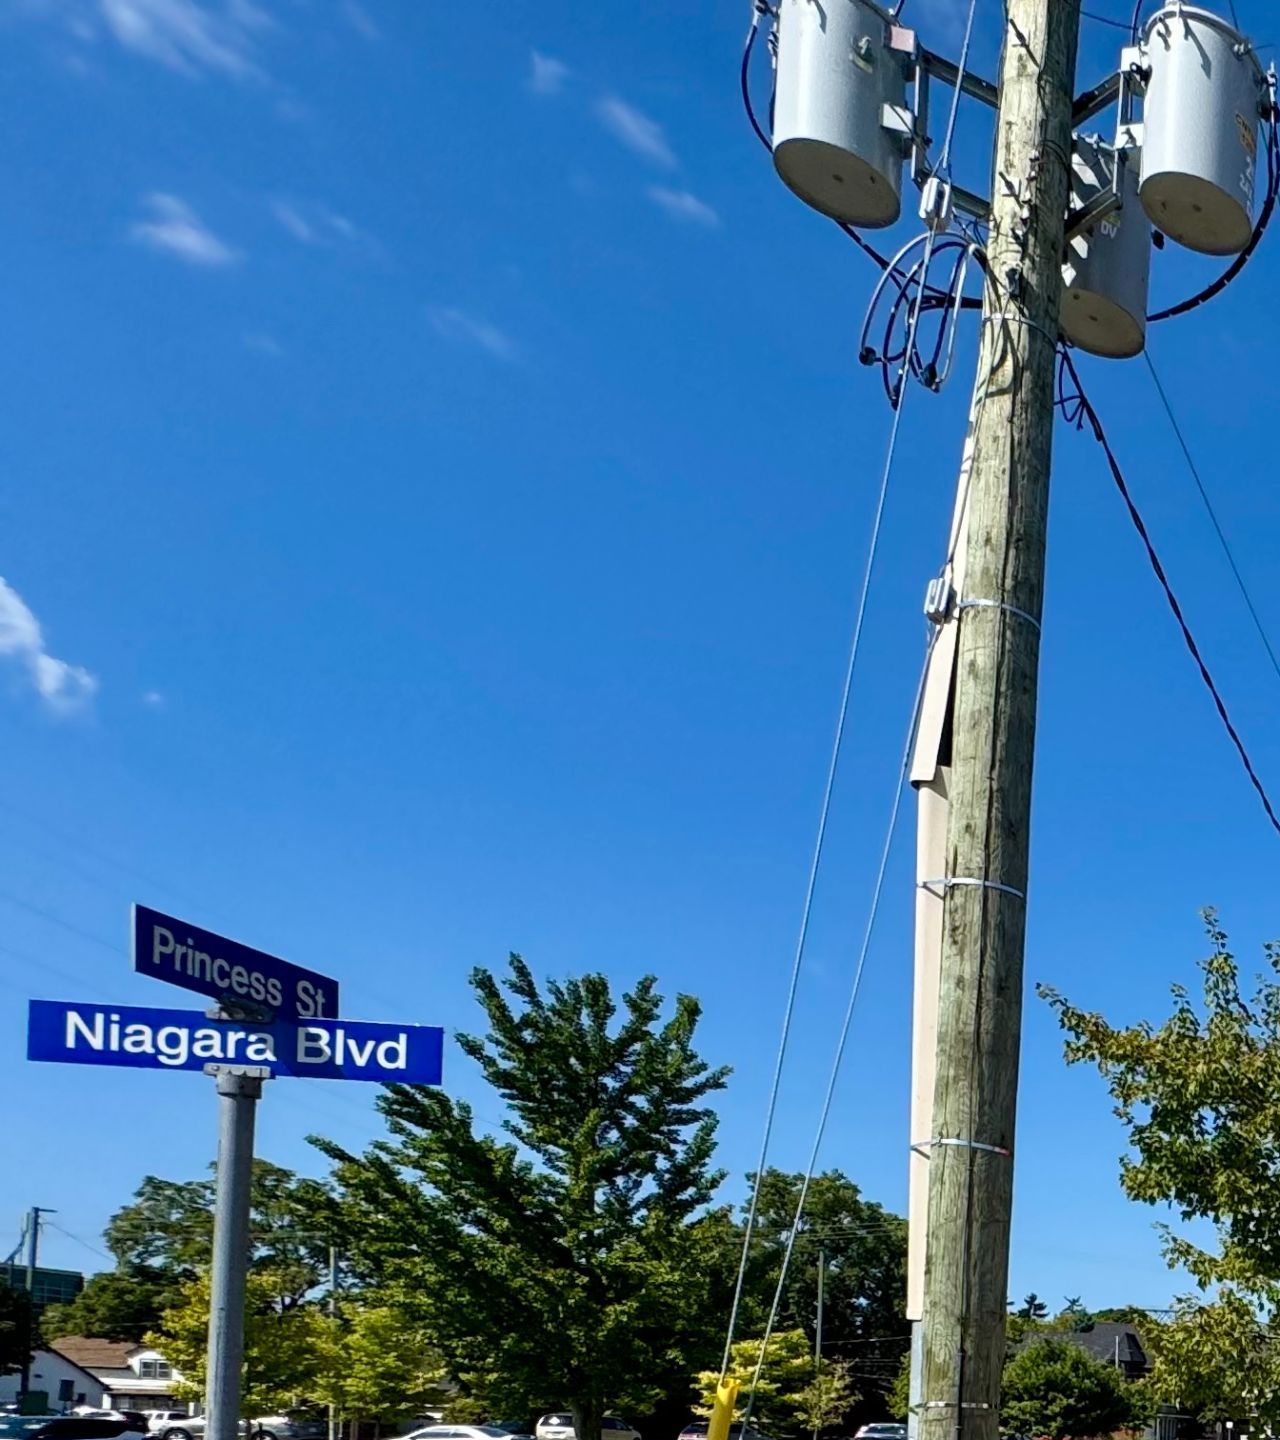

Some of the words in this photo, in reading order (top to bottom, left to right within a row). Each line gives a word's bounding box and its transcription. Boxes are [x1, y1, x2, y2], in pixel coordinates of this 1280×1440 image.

[152, 925, 283, 1007] Princess
[296, 980, 326, 1019] St
[65, 1011, 277, 1065] Niagara
[296, 1027, 408, 1070] Blvd
